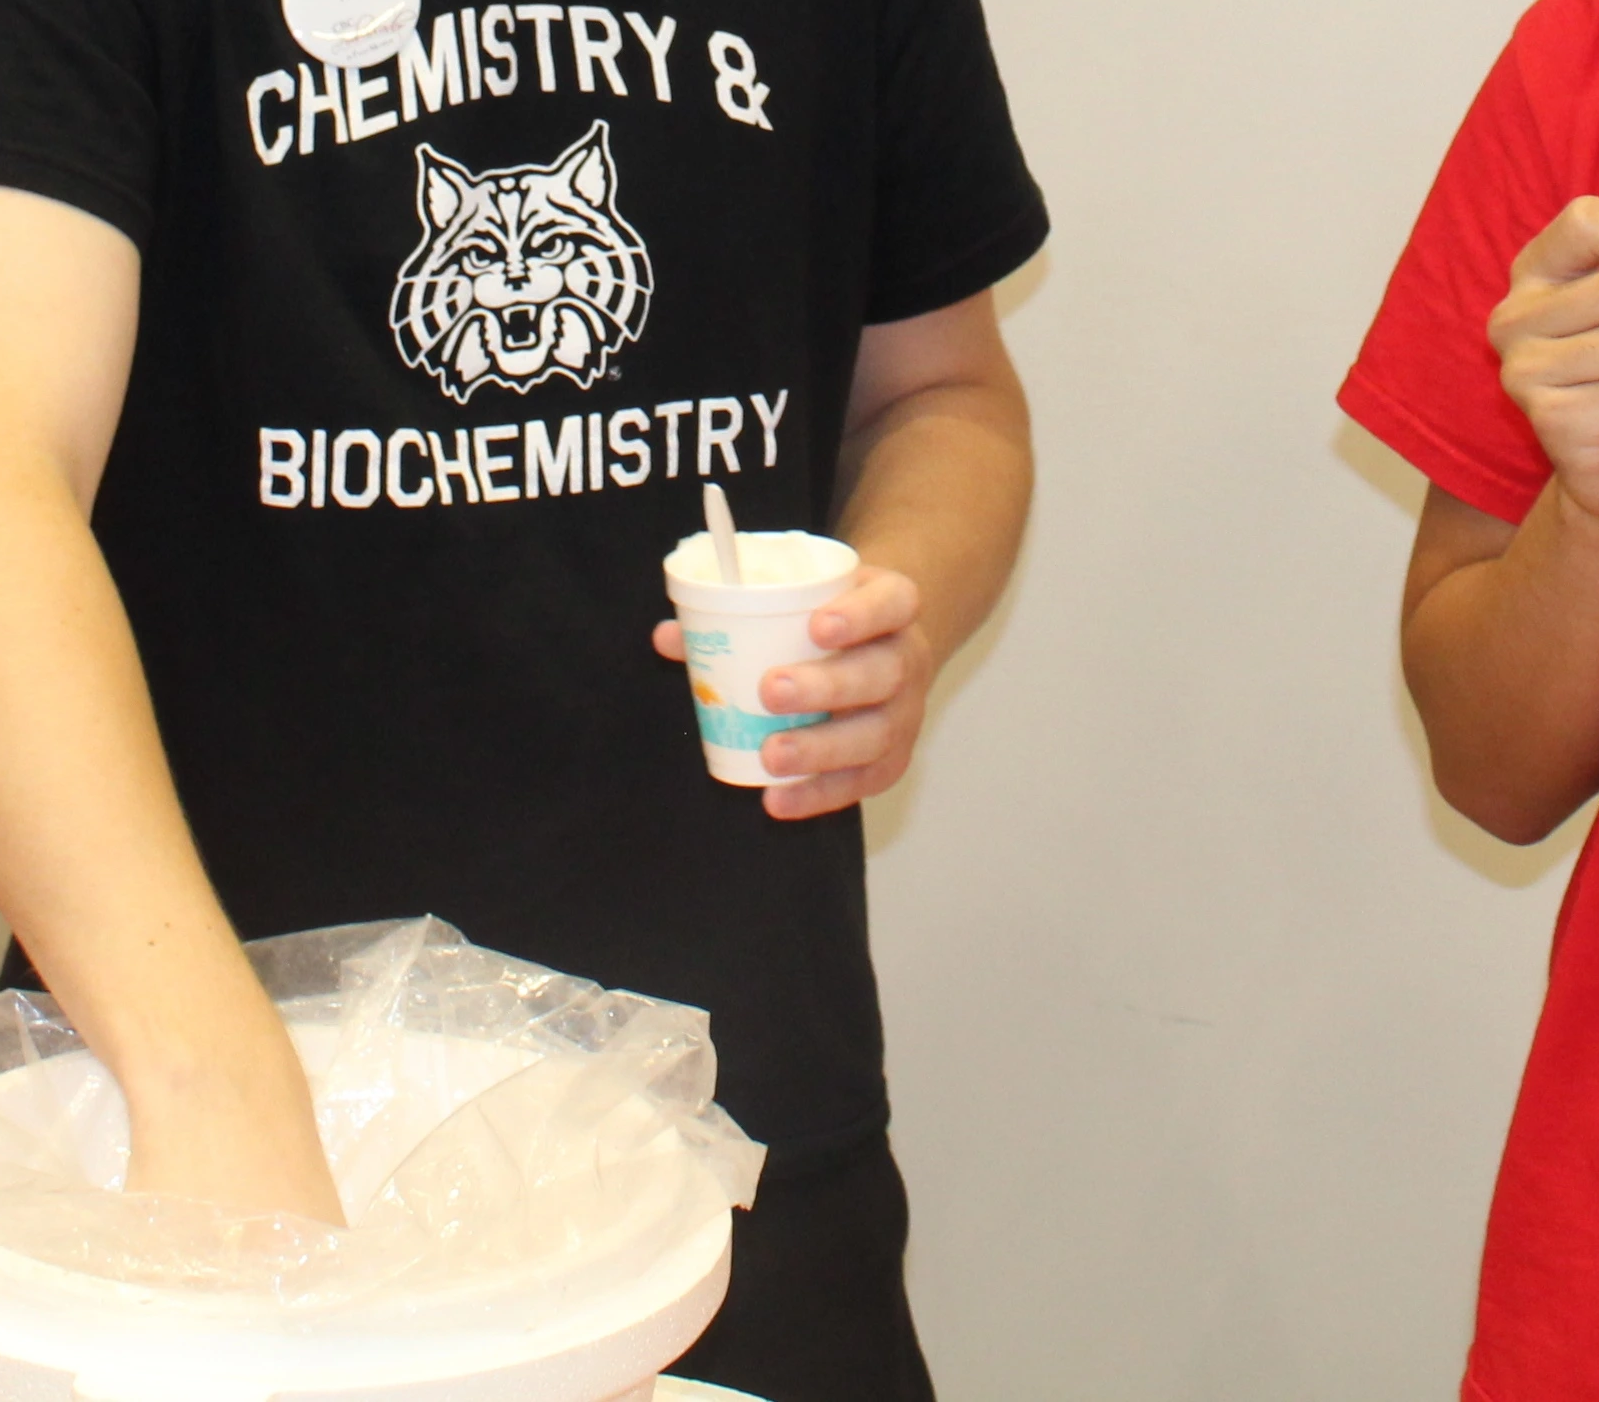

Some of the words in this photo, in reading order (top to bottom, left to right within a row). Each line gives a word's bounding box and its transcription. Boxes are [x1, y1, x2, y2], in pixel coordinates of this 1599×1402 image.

[246, 5, 676, 165] CHEMISTRY
[708, 30, 774, 131] &
[259, 389, 788, 509] BIOCHEMISTRY
